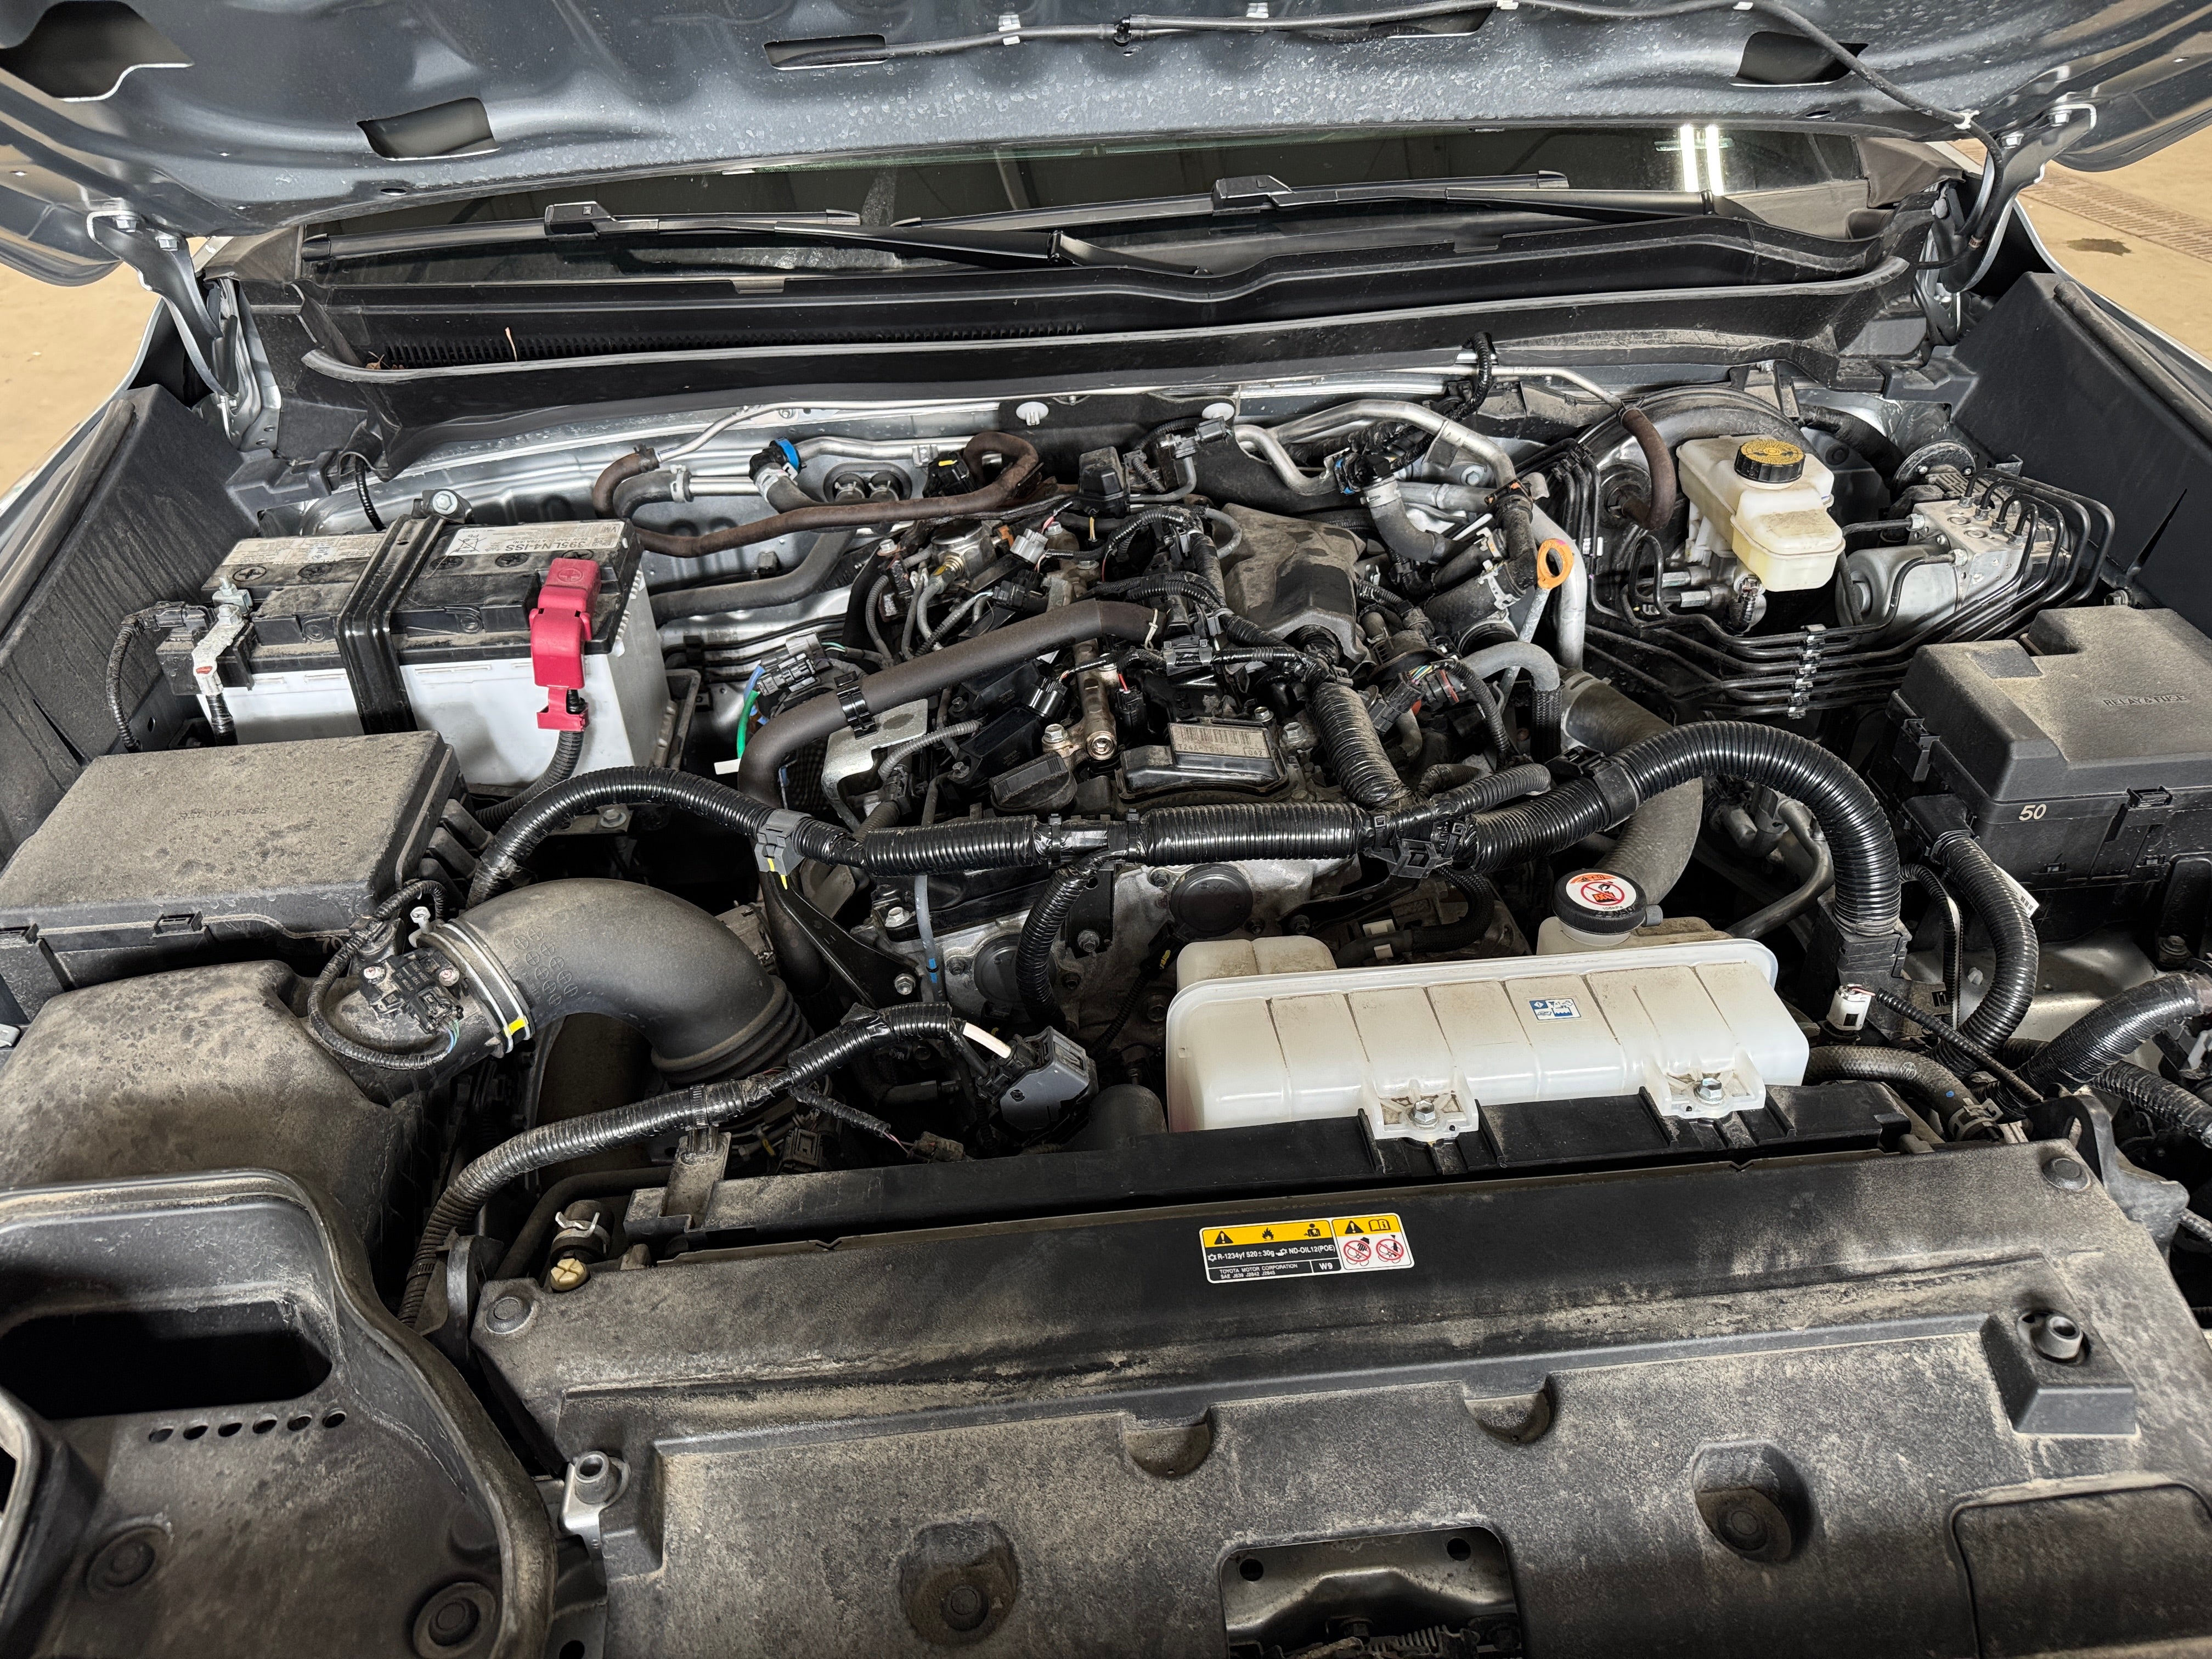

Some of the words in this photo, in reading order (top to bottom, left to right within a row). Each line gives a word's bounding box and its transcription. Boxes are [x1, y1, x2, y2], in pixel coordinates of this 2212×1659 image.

[505, 541, 586, 551] 395LN4-ISS
[2103, 698, 2142, 706] RELAY
[2153, 695, 2188, 703] FUSE
[2018, 804, 2047, 821] 50
[1595, 906, 1635, 918] DENSO
[315, 936, 345, 955] 70
[1288, 1244, 1335, 1255] ND-OIL12(POE)
[1217, 1251, 1245, 1260] R-1234yf
[1319, 1262, 1333, 1271] W9
